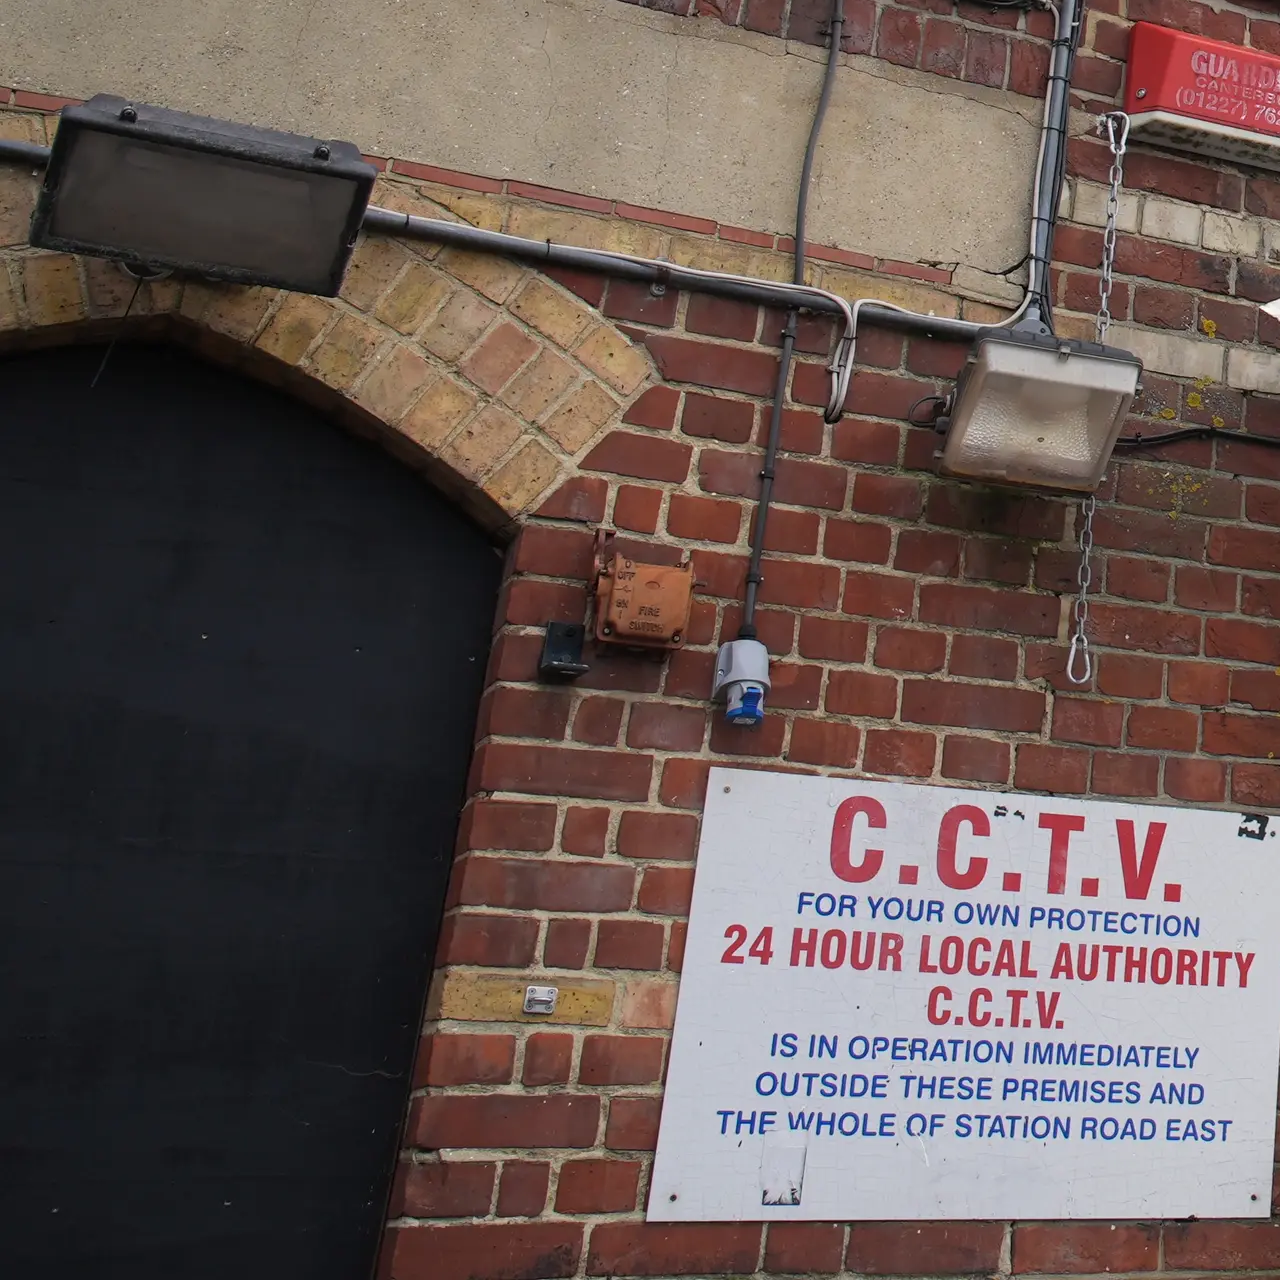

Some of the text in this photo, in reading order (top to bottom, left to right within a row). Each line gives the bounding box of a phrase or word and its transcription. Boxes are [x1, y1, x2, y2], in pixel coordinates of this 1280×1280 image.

[1175, 86, 1248, 120] (01227)
[628, 621, 664, 634] SWITCH
[638, 605, 660, 618] FIRE
[830, 795, 1182, 903] C.C.T.V.
[797, 892, 1200, 938] FOR YOUR OWN PROTECTION
[720, 924, 1256, 988] 24 HOUR LOCAL AUTHORITY
[927, 986, 1064, 1030] C.C.T.V.
[770, 1033, 1200, 1069] IS IN OPERATION IMMEDIATELY
[755, 1071, 1205, 1105] OUTSIDE THESE PREMISES AND
[716, 1110, 1233, 1142] THE WHOLE OF STATION ROAD EAST
